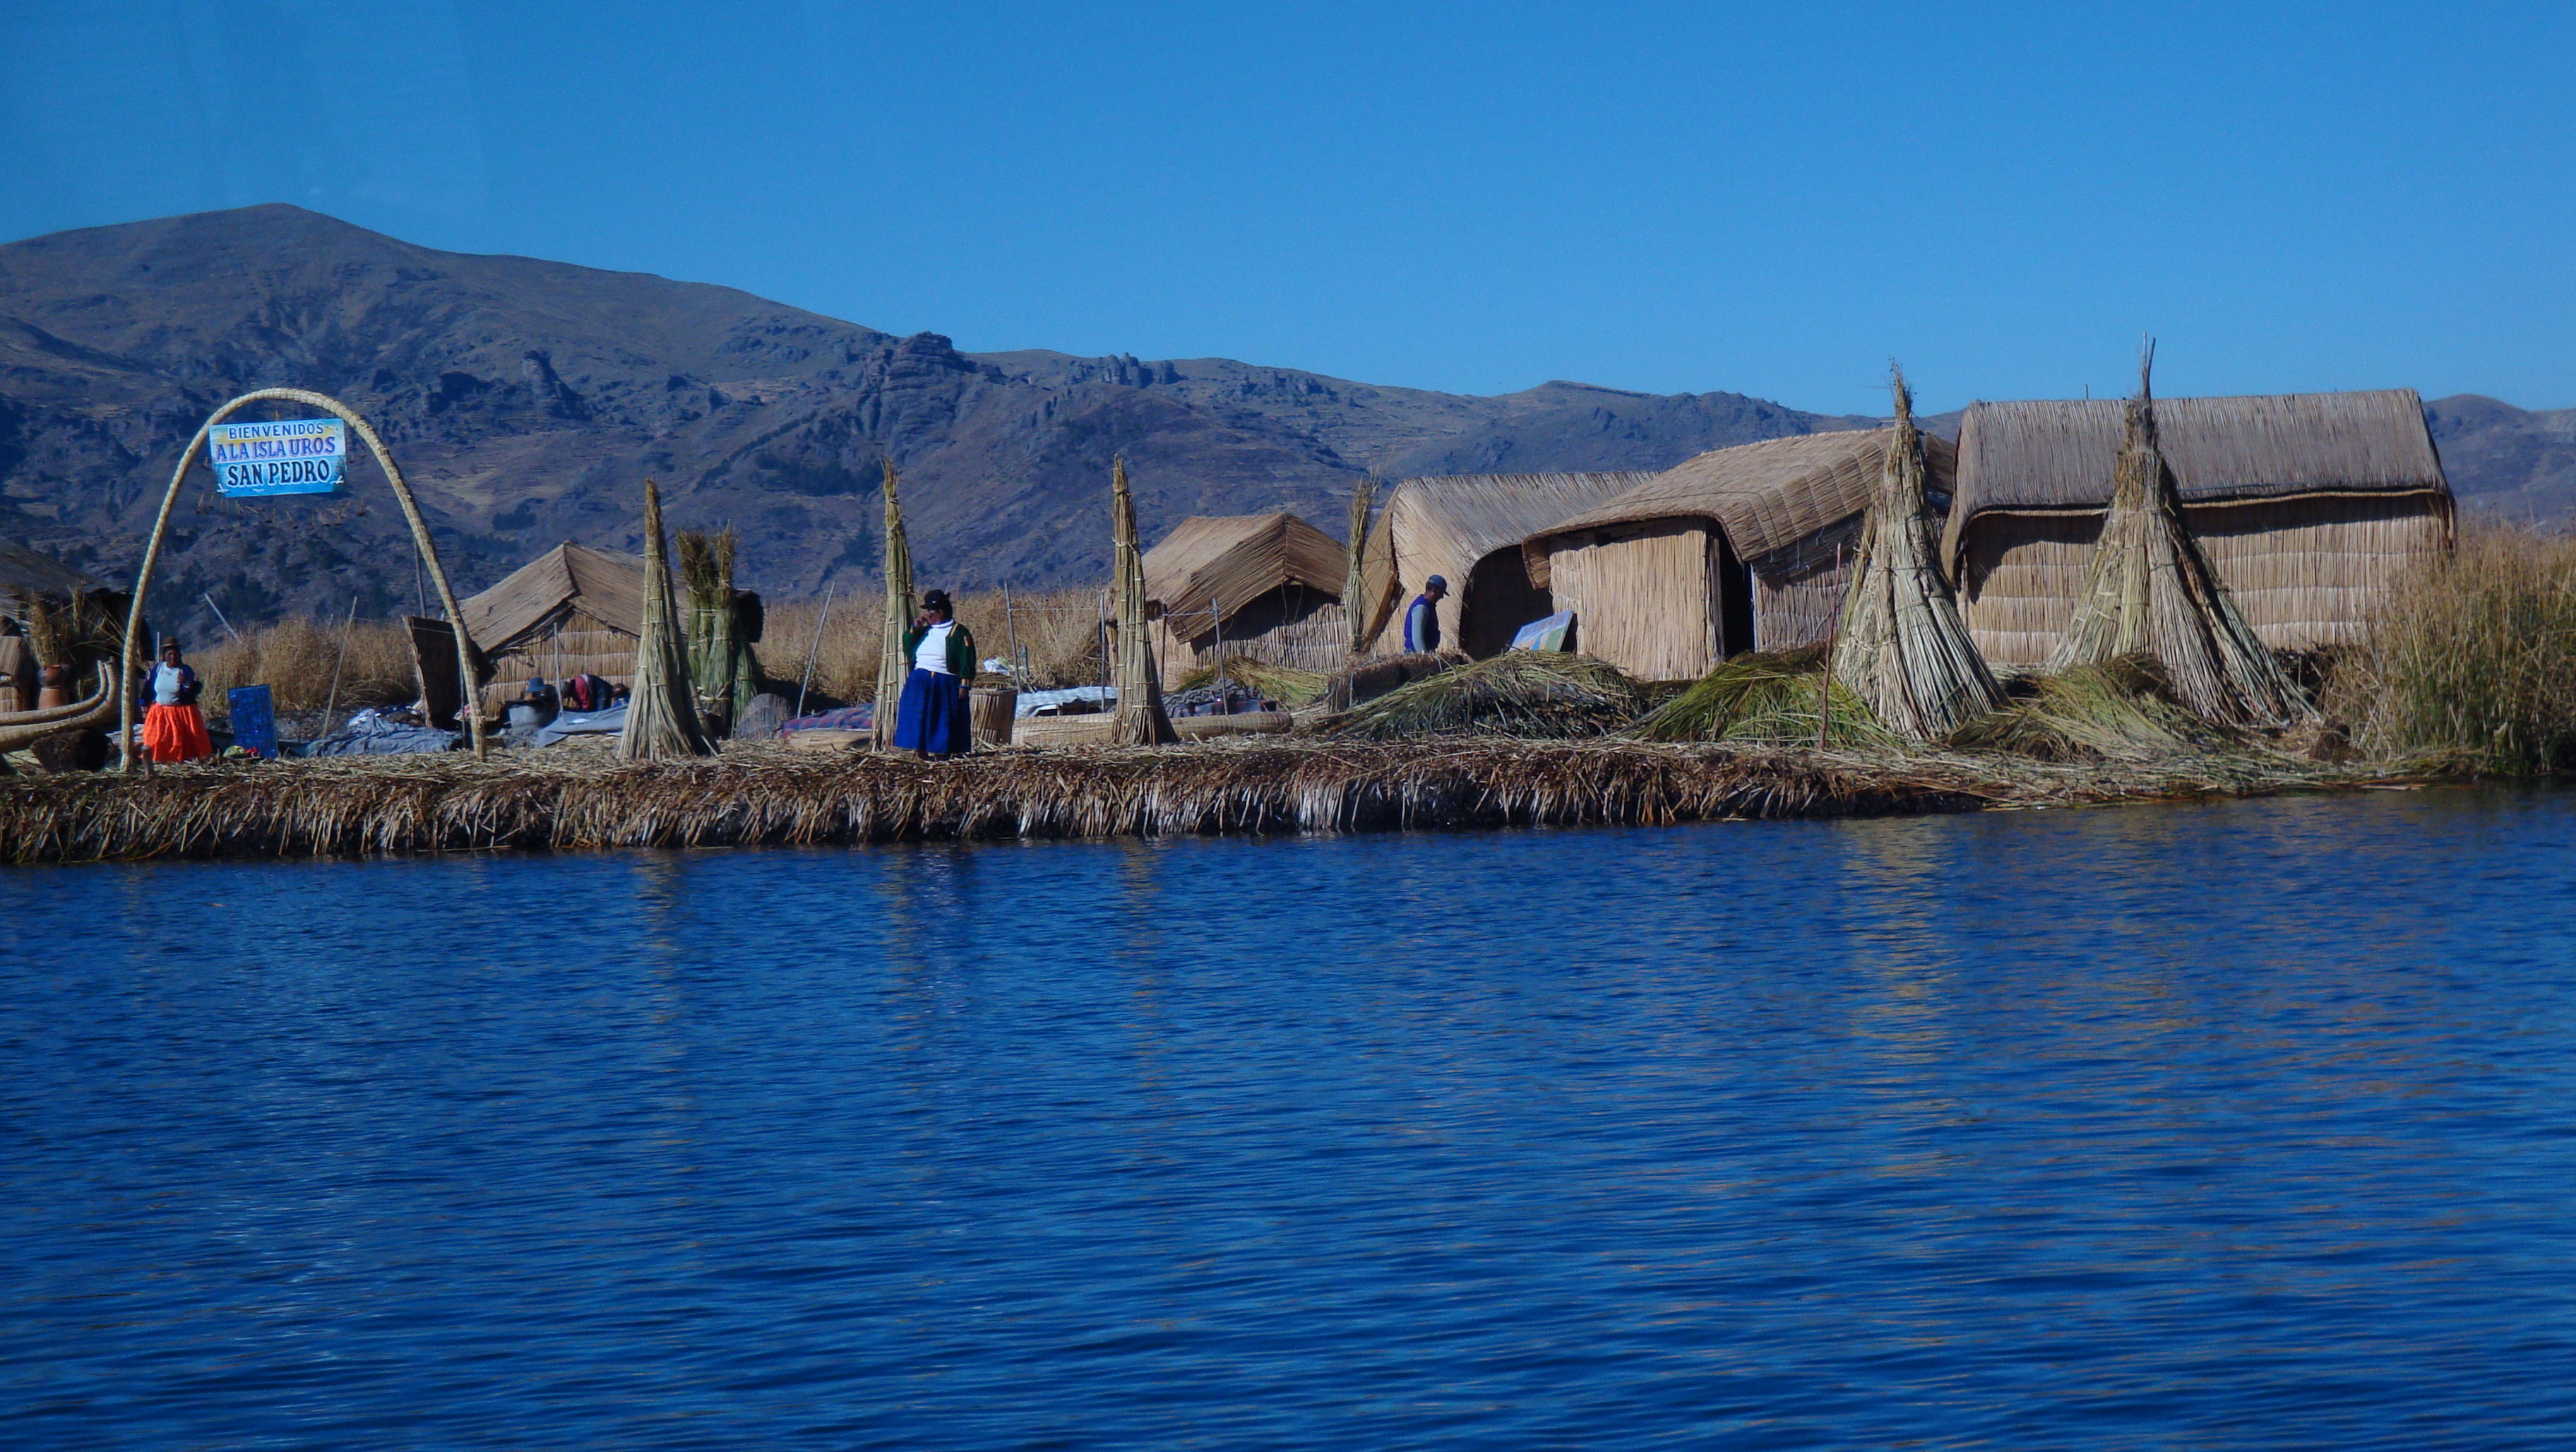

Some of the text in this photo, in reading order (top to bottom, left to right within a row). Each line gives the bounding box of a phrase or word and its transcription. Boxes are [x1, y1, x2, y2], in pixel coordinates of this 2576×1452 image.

[229, 423, 324, 439] BIENVENIDOS
[216, 436, 336, 462] A LA ISLA UROS
[227, 460, 330, 486] SAN PEDRO
